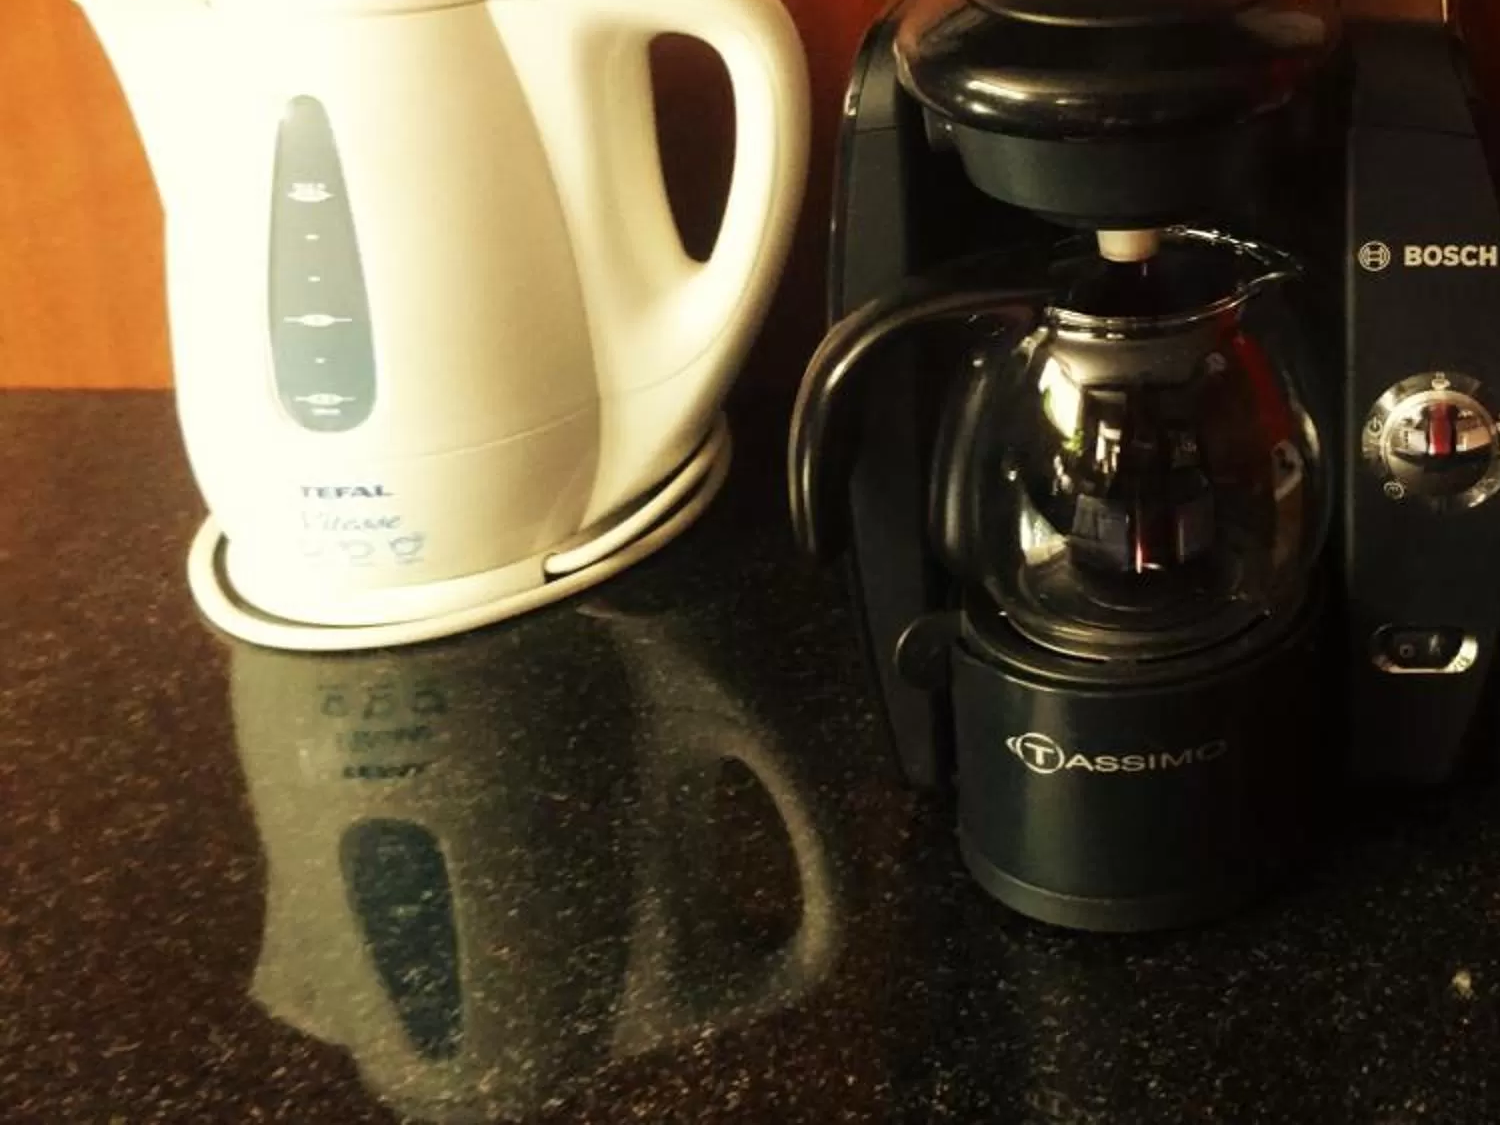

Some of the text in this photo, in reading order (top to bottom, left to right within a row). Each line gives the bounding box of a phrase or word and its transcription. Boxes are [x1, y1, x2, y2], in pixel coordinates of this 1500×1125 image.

[1404, 245, 1498, 267] BOSCH
[300, 483, 395, 499] TEFAL
[1005, 732, 1228, 774] TASSIMO
